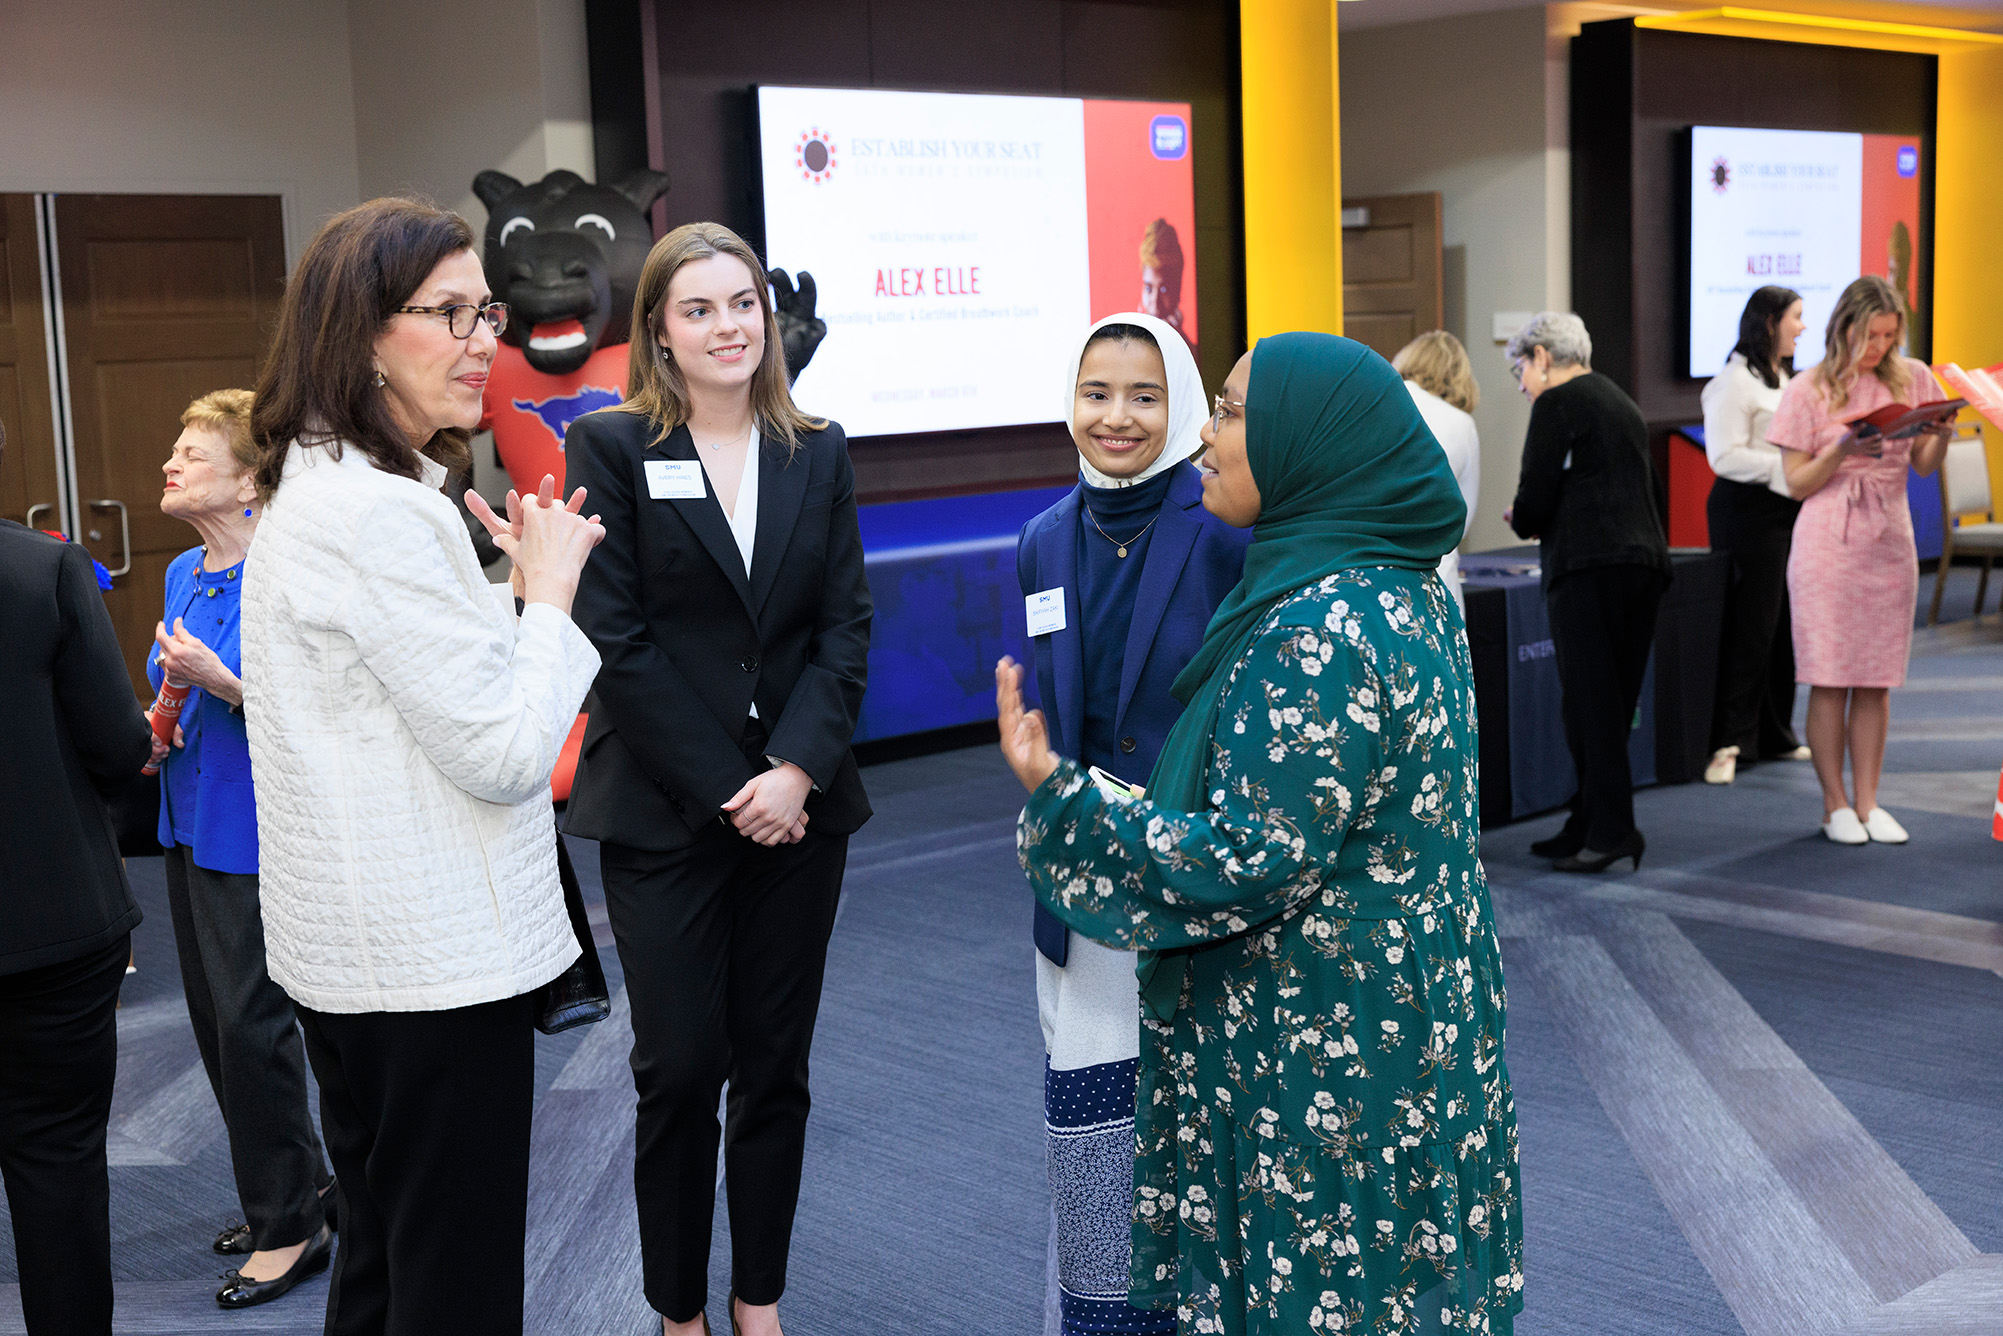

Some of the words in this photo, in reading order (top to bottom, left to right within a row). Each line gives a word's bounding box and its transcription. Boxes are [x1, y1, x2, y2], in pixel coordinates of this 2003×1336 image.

[851, 137, 947, 158] ESTABLISH
[951, 139, 997, 159] YOUR
[1000, 141, 1042, 160] SEAT
[1747, 254, 1772, 276] ALEX
[1777, 253, 1802, 275] ELLE
[875, 267, 925, 297] ALEX
[934, 266, 981, 295] ELLE
[1039, 595, 1051, 603] SMU
[157, 691, 178, 708] ALEX
